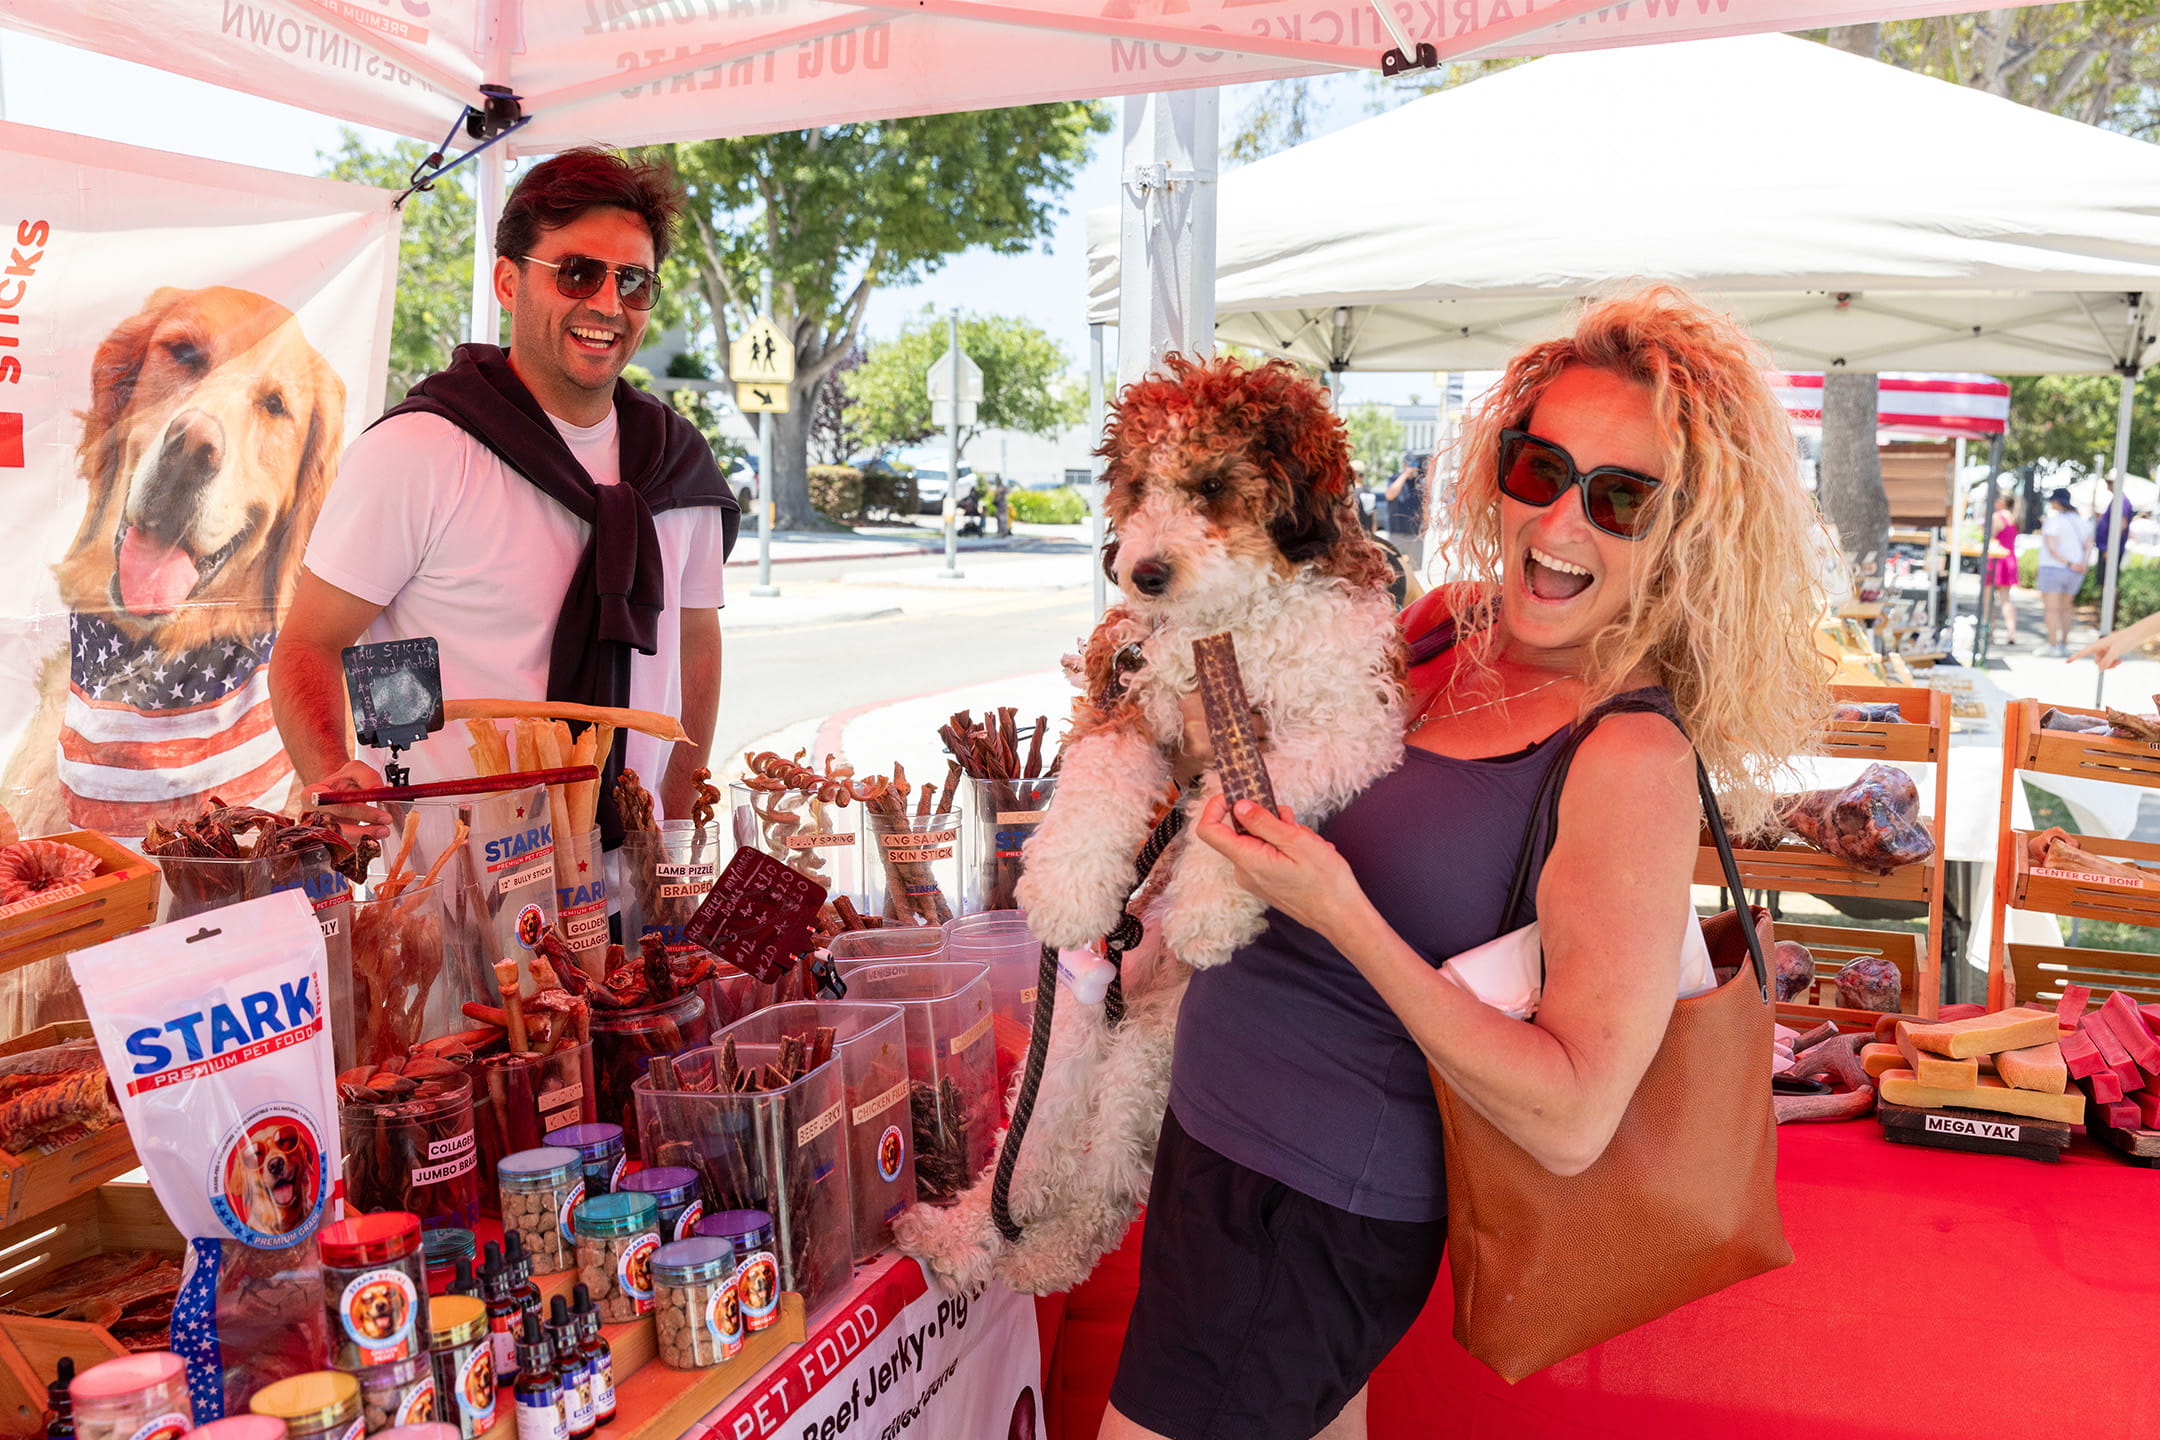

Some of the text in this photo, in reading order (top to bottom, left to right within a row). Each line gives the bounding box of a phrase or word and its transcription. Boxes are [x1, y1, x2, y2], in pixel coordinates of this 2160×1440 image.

[485, 824, 552, 862] STARK
[819, 834, 854, 845] SPRING
[889, 847, 952, 861] SKIN STICK
[513, 873, 531, 885] BULLY
[532, 866, 553, 879] STICKS
[657, 865, 713, 876] LAMB PIZZLE
[2036, 867, 2140, 888] CENTER CUT BONE
[556, 877, 606, 908] TAR
[663, 881, 713, 897] BRAIDED
[907, 884, 938, 893] STARK
[0, 886, 82, 918] UT TRACHEA
[329, 897, 346, 906] FOOD
[559, 908, 587, 917] REMIUM
[571, 918, 605, 933] GOLDEN
[642, 925, 689, 944] STA
[567, 933, 609, 950] COLLAGEN
[125, 976, 316, 1075] STARK
[154, 1027, 314, 1088] PREMIUM PET FOOD
[856, 1094, 891, 1121] CHICKEN
[1928, 1117, 2016, 1140] MEGA YAK
[430, 1135, 473, 1155] COLLAGEN
[416, 1164, 457, 1182] JUMBO
[254, 1213, 319, 1245] PREMIUM GRADE
[733, 1378, 789, 1440] PET
[798, 1304, 878, 1392] FOOD
[802, 1377, 860, 1440] Beef
